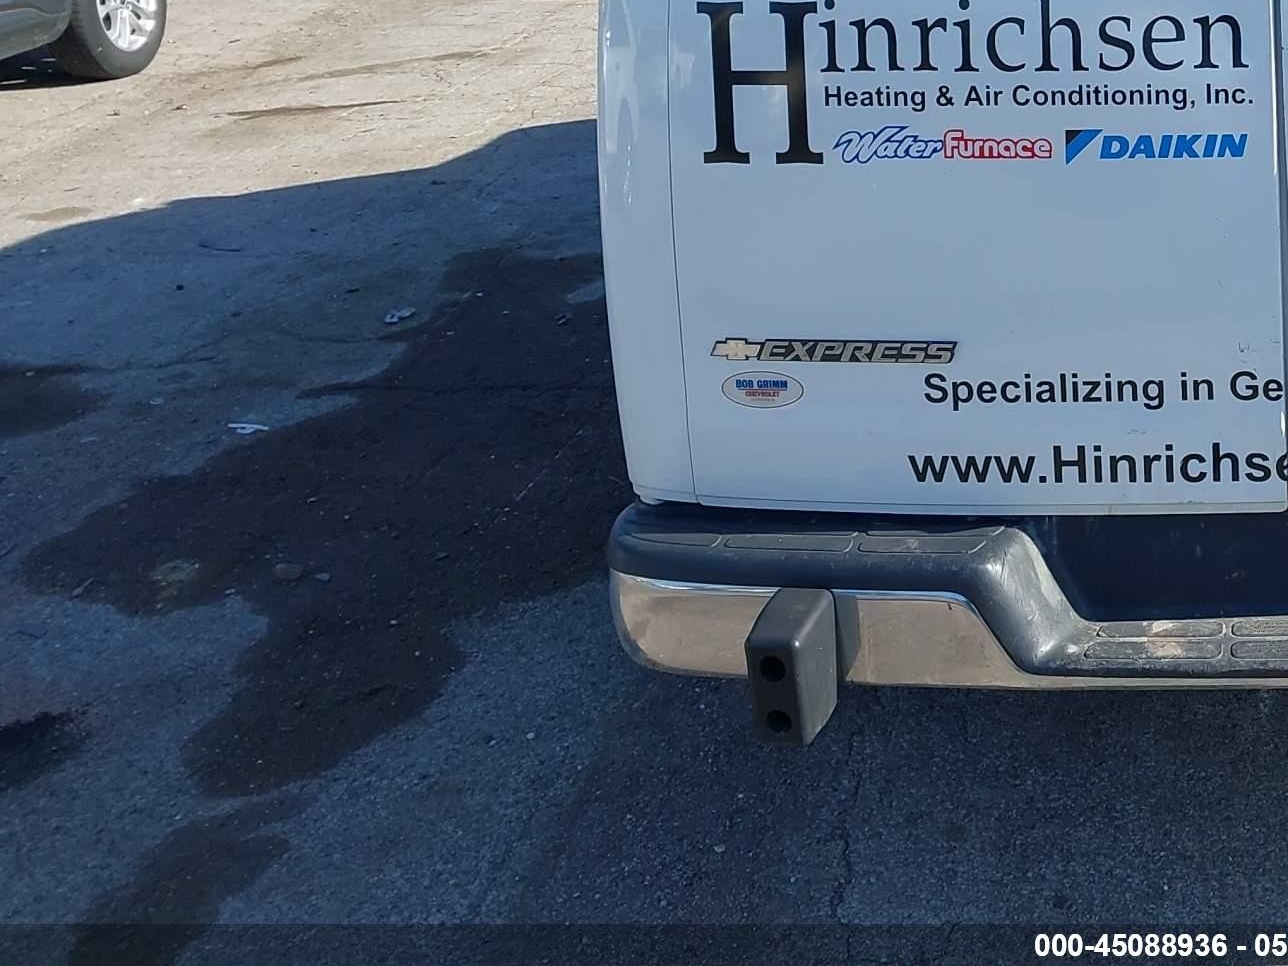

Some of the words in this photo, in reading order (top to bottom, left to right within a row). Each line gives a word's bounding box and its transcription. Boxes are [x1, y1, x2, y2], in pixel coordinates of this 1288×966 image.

[824, 85, 927, 110] Heating
[935, 85, 956, 107] &
[963, 84, 1005, 107] Air
[1012, 83, 1197, 111] Conditioning,
[1206, 83, 1255, 106] Inc.
[1100, 133, 1248, 159] DAIKIN
[757, 339, 957, 364] EXPRESS
[735, 379, 754, 388] BOB
[756, 379, 788, 389] GRIMM
[923, 372, 1165, 412] Specializing
[1180, 371, 1214, 401] in
